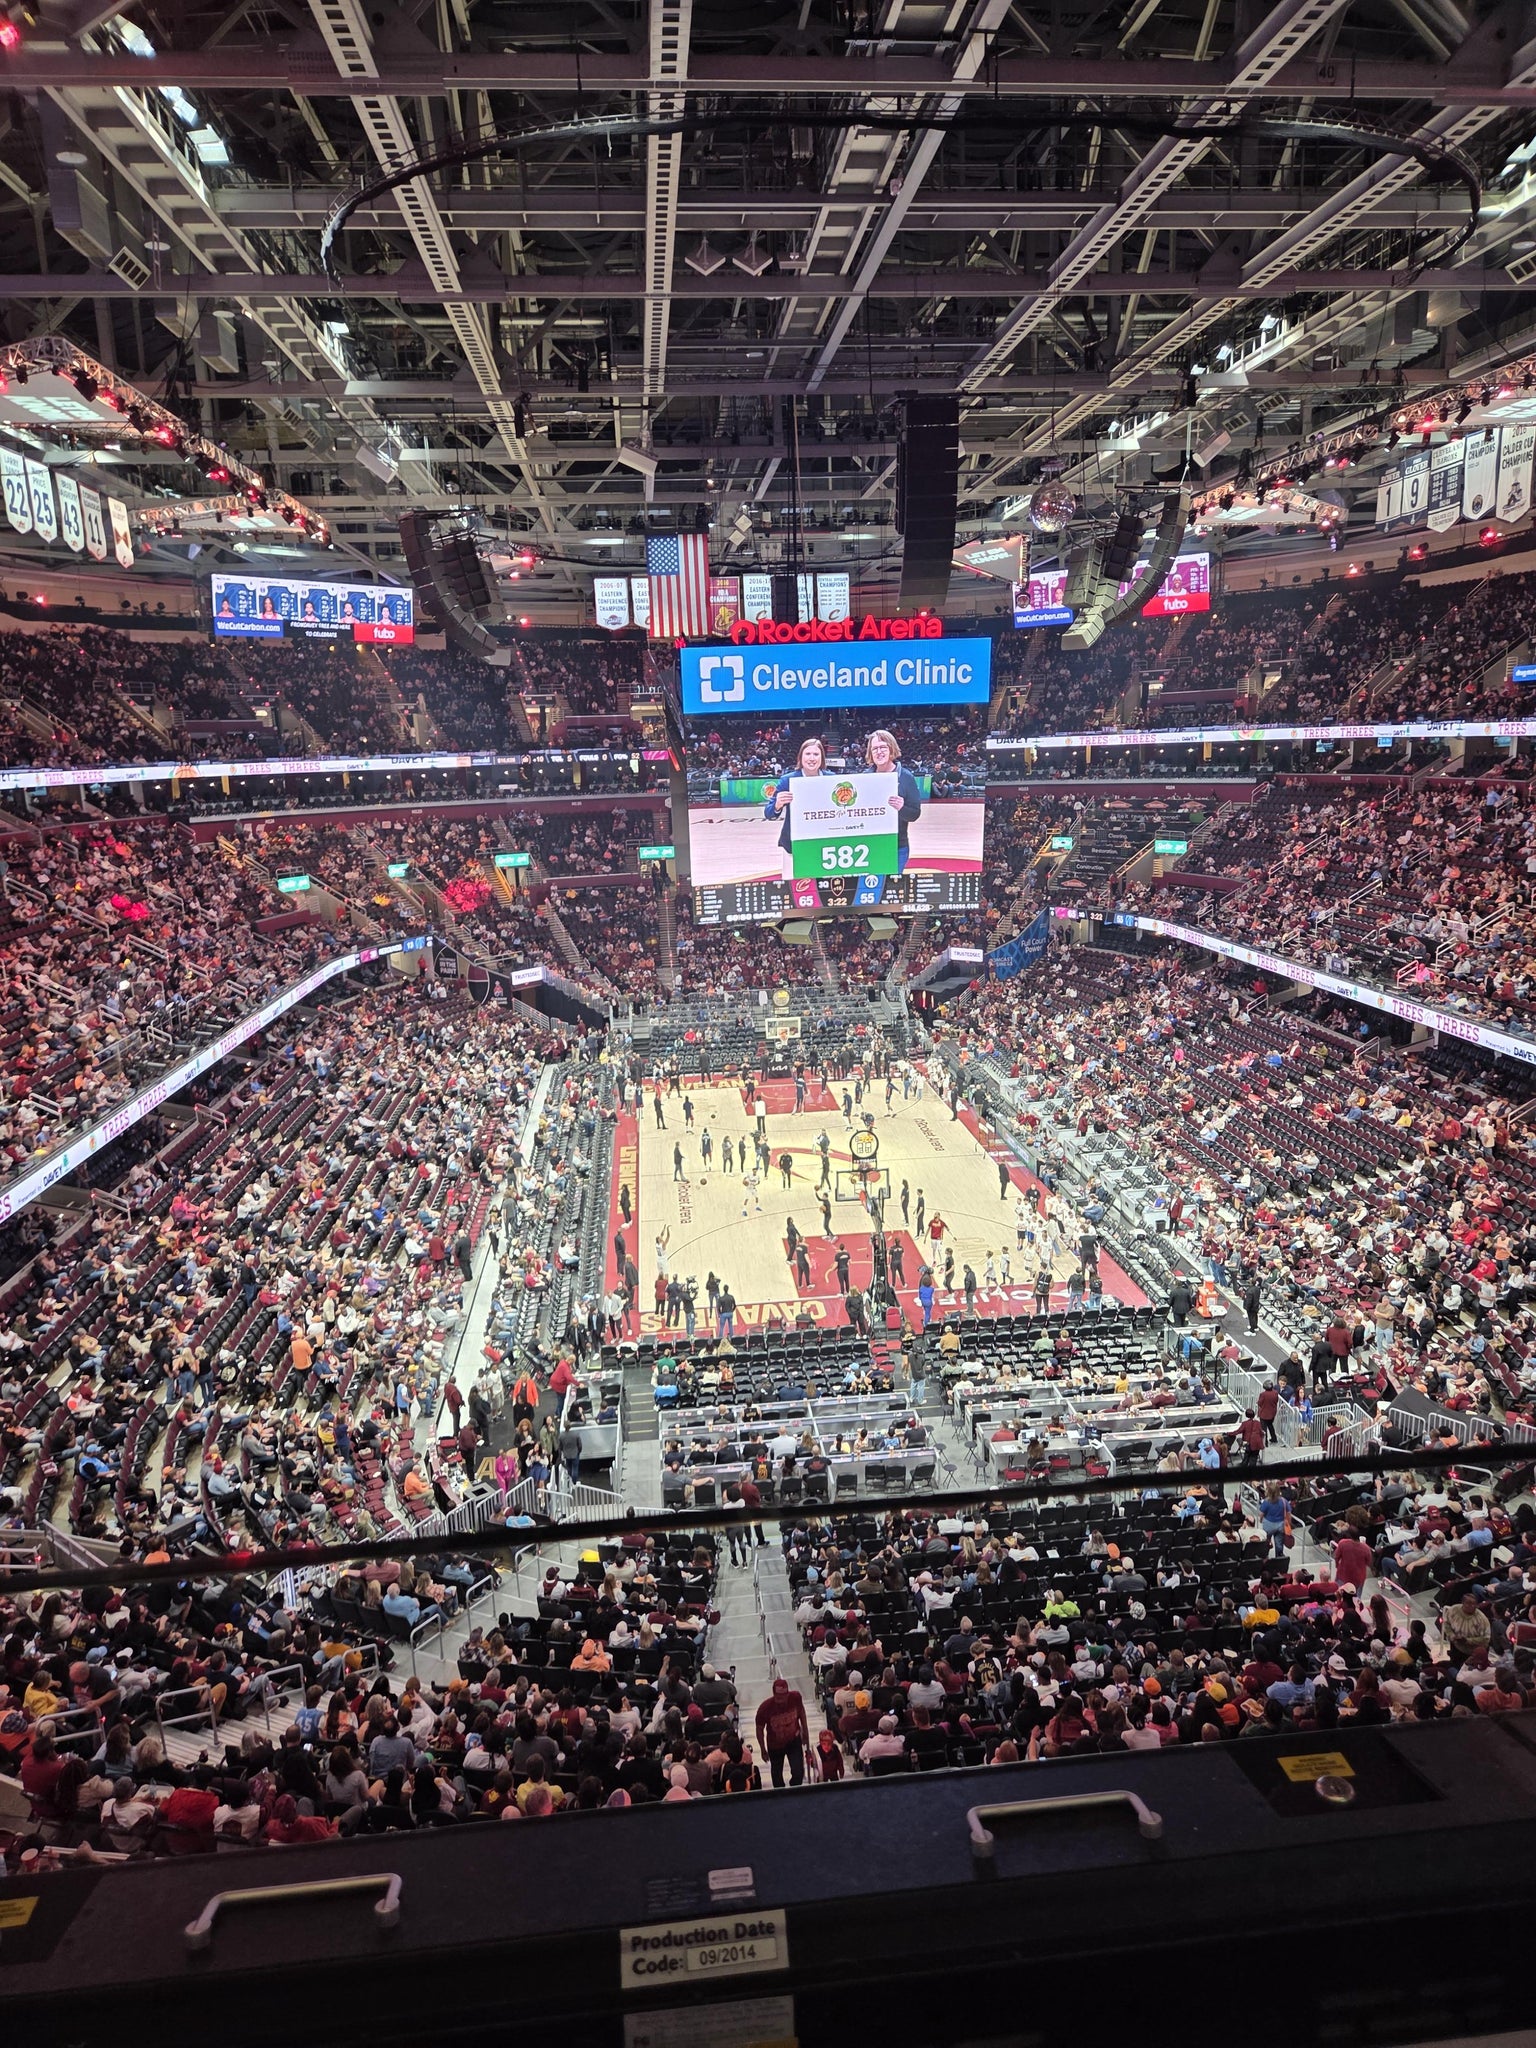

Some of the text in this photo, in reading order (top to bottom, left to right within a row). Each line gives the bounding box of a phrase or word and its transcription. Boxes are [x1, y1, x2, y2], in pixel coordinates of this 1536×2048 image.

[1468, 443, 1496, 460] CHAMPIONS
[1503, 440, 1523, 456] CALDER
[1405, 460, 1429, 474] GLOVER
[1501, 450, 1534, 470] CHAMPIONS
[6, 478, 28, 518] 22
[1410, 478, 1420, 509] 9
[33, 488, 53, 526] 25
[1386, 486, 1392, 517] 1
[63, 502, 80, 538] 43
[88, 512, 103, 546] 11
[709, 595, 738, 603] CHAMPIONS
[1163, 598, 1189, 611] fubo
[1016, 612, 1071, 624] WeCutCarbon.com
[216, 621, 281, 633] WeCutCarbon.com
[312, 630, 338, 638] CELEBRATE
[373, 626, 396, 640] fubo
[758, 613, 943, 644] Rocket Arena
[752, 657, 973, 691] Cleveland Clinic
[1304, 728, 1331, 738] TREES
[1340, 727, 1375, 737] THREES
[1426, 722, 1454, 731] DAVEY
[1497, 723, 1527, 735] TREES
[1079, 736, 1109, 745] TREES
[1119, 734, 1157, 744] THREES
[391, 757, 425, 765] DAVEY
[579, 754, 599, 762] FOULS
[602, 753, 608, 761] 0
[631, 752, 640, 760] 52
[242, 764, 272, 774] TREES
[281, 762, 321, 773] THREES
[44, 773, 65, 785] TREES
[72, 770, 104, 783] THREES
[803, 807, 886, 821] TREES THREES
[821, 844, 870, 870] 582
[818, 880, 830, 889] 3Q
[799, 895, 814, 907] 65
[827, 897, 848, 907] 3:22
[860, 892, 875, 904] 55
[1090, 912, 1103, 921] 3:22
[1163, 922, 1179, 937] TREES
[1184, 929, 1205, 946] THREES
[1021, 937, 1047, 948] Full Court
[1025, 945, 1043, 954] Power
[1257, 954, 1279, 972] TREES
[1286, 964, 1316, 985] THREES
[1336, 985, 1353, 998] DAVEY
[1392, 999, 1424, 1022] TREES
[1435, 1014, 1480, 1042] THREES
[1485, 1039, 1506, 1050] Presented
[220, 1015, 261, 1055] TREES THREES
[102, 1067, 198, 1142] TREES THREES DAVEY
[42, 1165, 64, 1187] DAVEY
[631, 1919, 776, 1952] Production Date
[632, 1944, 756, 1976] Code: 09/2014
